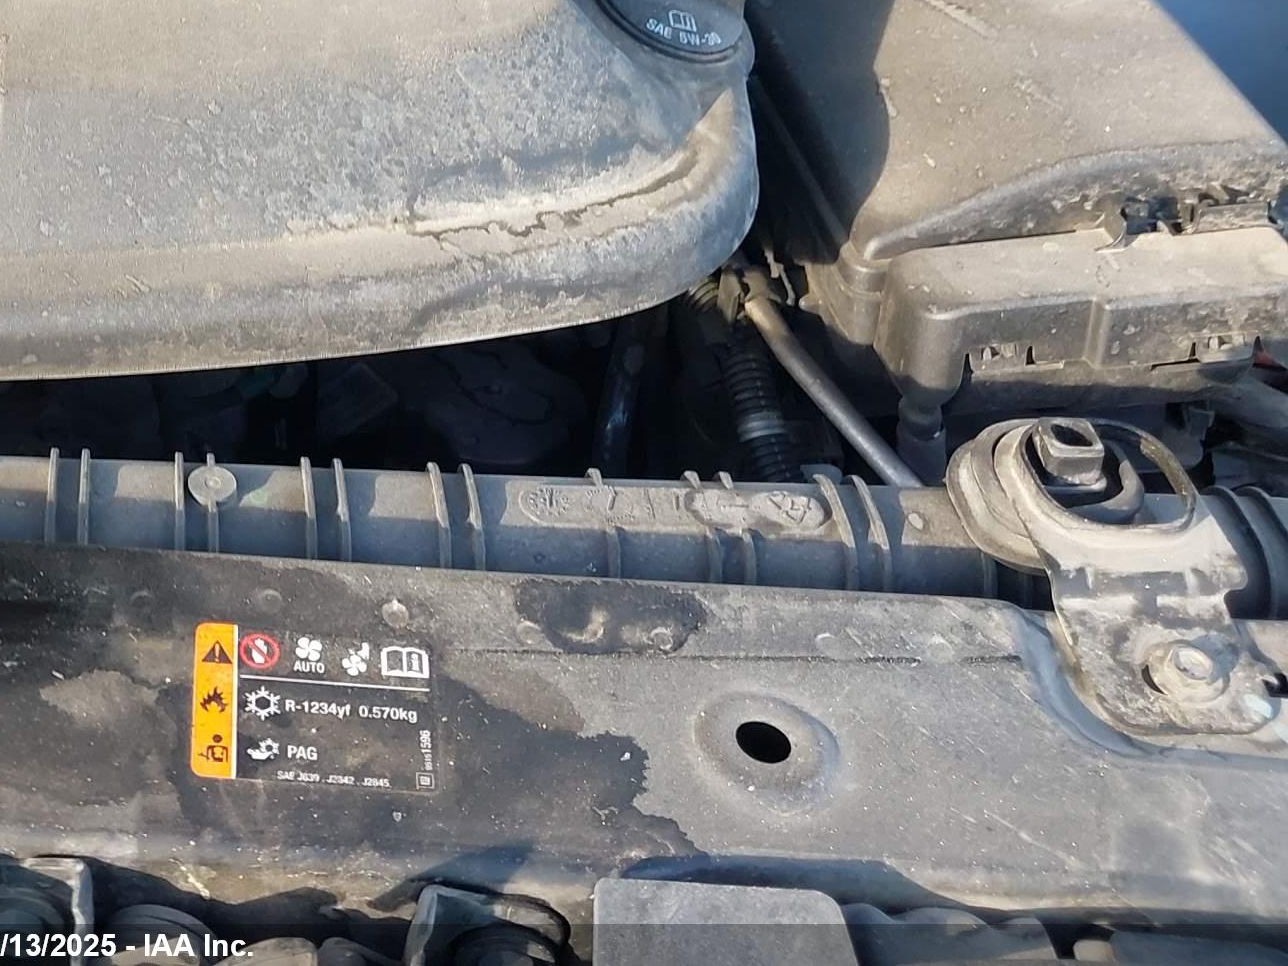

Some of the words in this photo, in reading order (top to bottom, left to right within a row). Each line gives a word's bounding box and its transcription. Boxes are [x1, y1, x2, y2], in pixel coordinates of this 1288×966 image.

[646, 18, 672, 40] SAE
[293, 660, 325, 675] AUTO
[284, 698, 352, 721] R-1234yf
[358, 704, 419, 724] 0.570kg
[287, 744, 319, 761] PAG
